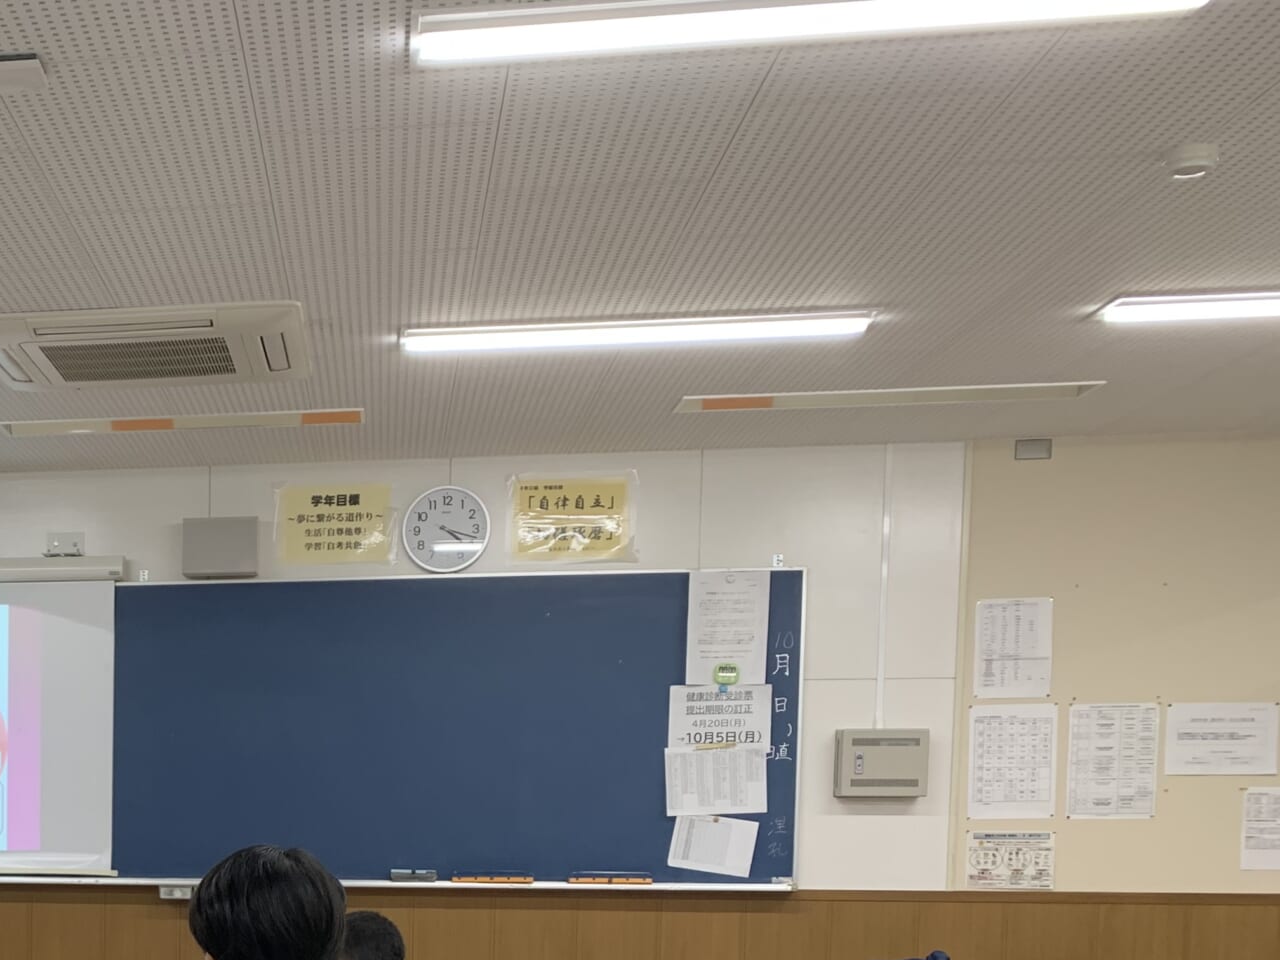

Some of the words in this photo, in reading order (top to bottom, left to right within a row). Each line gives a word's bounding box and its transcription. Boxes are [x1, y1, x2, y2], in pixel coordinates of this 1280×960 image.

[311, 494, 361, 507] 学年目標
[428, 498, 437, 511] 11
[442, 495, 453, 506] 12
[460, 499, 465, 510] 1
[417, 511, 428, 521] 10
[468, 508, 477, 519] 2
[413, 525, 420, 536] 9
[472, 523, 480, 534] 3
[417, 540, 425, 550] 8
[772, 653, 790, 676] 月
